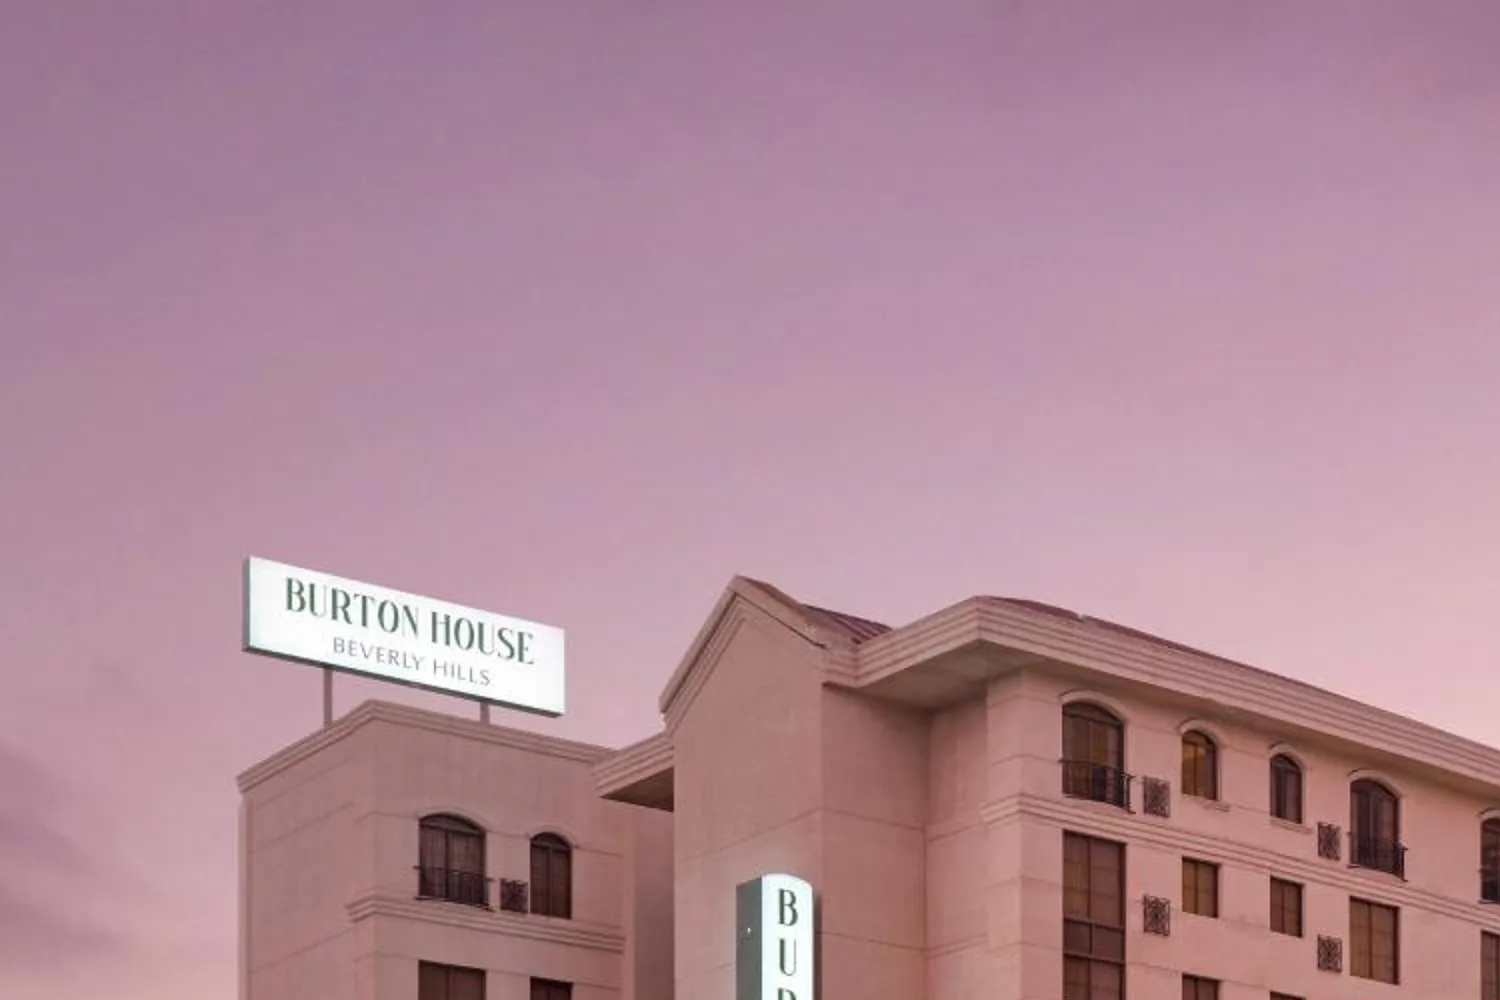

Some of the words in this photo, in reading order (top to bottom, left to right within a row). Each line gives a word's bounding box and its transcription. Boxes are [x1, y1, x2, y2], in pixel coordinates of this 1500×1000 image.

[285, 576, 419, 638] BURTON
[430, 611, 535, 665] HOUSE
[333, 637, 424, 671] BEVERLY
[433, 658, 491, 687] HILLS
